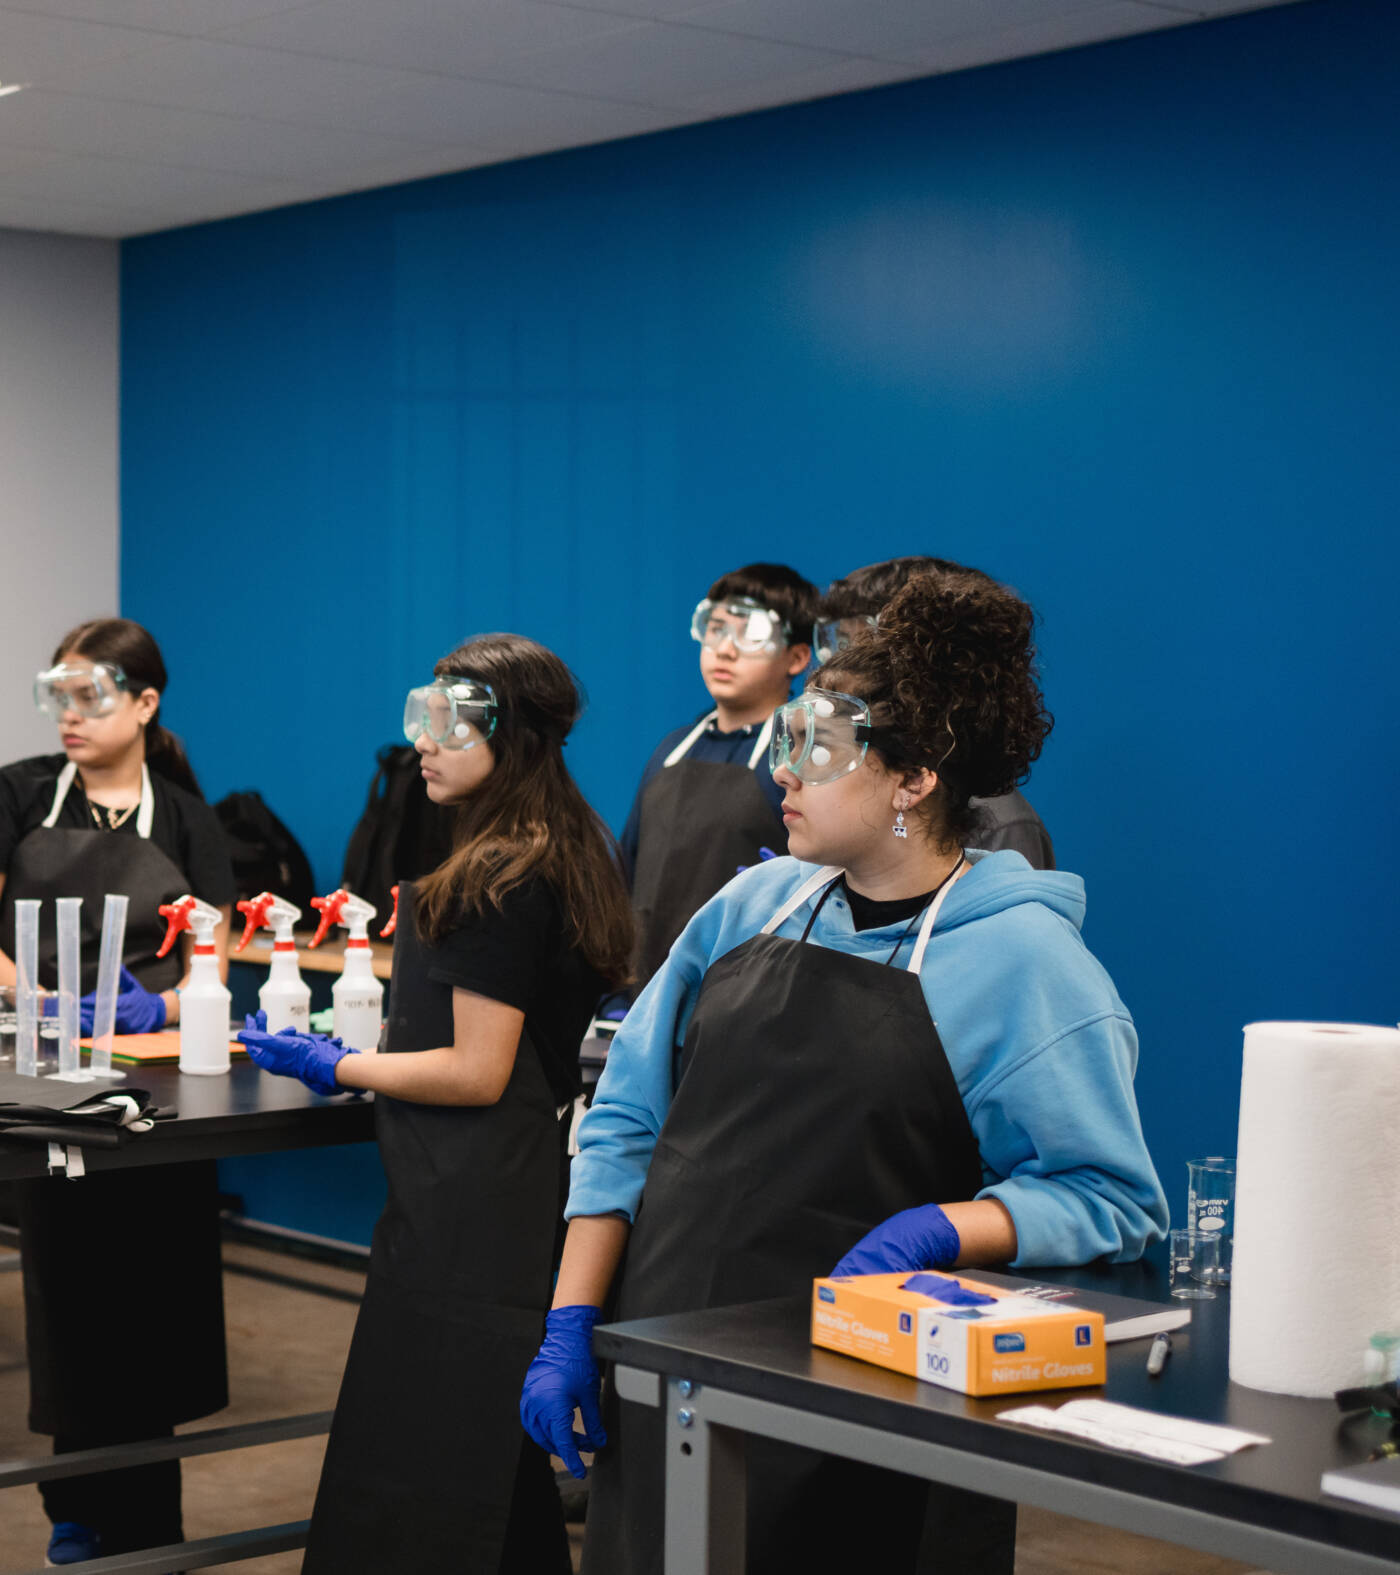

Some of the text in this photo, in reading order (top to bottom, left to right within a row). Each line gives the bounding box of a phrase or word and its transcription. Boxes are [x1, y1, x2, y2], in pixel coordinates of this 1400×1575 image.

[815, 1309, 849, 1332] Nitrile
[851, 1320, 889, 1344] Gloves
[925, 1352, 949, 1374] 100
[991, 1361, 1094, 1384] Nitrile Gloves
